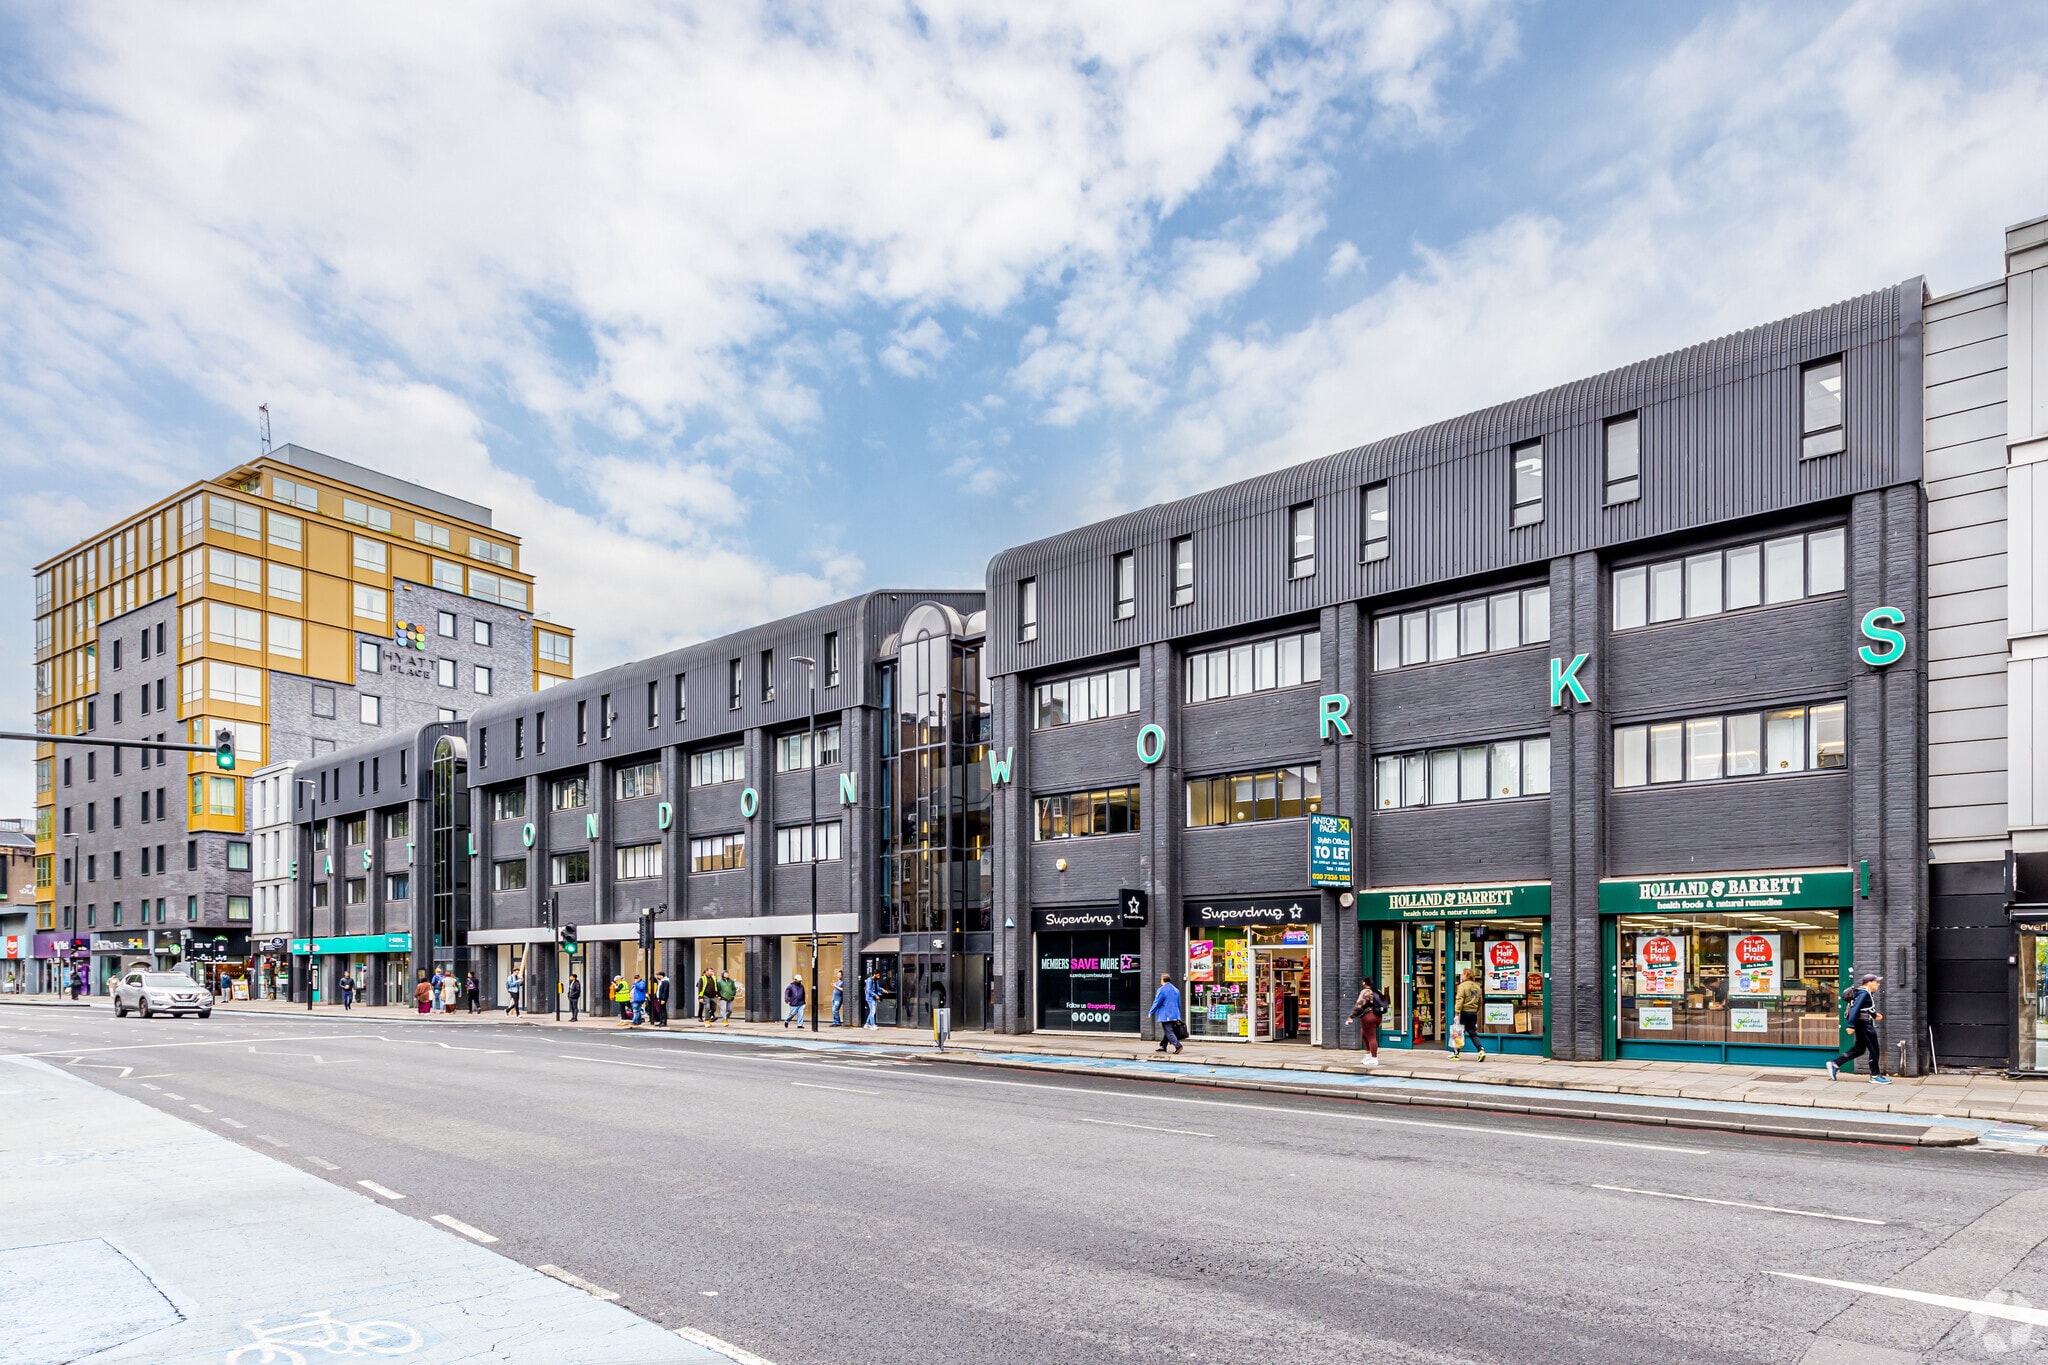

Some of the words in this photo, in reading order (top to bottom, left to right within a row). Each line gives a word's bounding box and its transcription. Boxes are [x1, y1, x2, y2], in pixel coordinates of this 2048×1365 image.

[383, 650, 437, 670] HYATT
[390, 664, 430, 679] PLACE
[289, 841, 415, 880] EAST
[467, 771, 858, 857] LONDON
[987, 606, 1908, 786] WORKS
[1312, 816, 1338, 826] ANTON
[1320, 824, 1338, 834] PAGE
[1314, 845, 1331, 859] TO
[1332, 846, 1350, 860] LET
[1639, 880, 1709, 900] HOLLAND
[1710, 880, 1725, 897] &
[1727, 877, 1803, 895] BARRETT
[1388, 893, 1443, 910] HOLLAND
[1444, 892, 1456, 907] &
[1457, 890, 1514, 906] BARRETT
[1657, 900, 1680, 910] health
[1682, 900, 1704, 909] foods
[1716, 898, 1744, 908] natural
[1745, 897, 1783, 907] remedies
[1201, 906, 1285, 921] Superdrug
[1422, 909, 1439, 917] foods
[1447, 908, 1468, 916] natural
[1469, 907, 1497, 915] remedies
[1045, 913, 1114, 927] Superdrug
[1496, 948, 1513, 957] Half
[1650, 945, 1670, 953] Half
[1743, 944, 1765, 953] Half
[1496, 956, 1514, 964] Price
[1650, 953, 1671, 962] Price
[1743, 953, 1766, 961] Price
[1041, 958, 1070, 970] MEMBERS
[1070, 957, 1099, 970] SAVE
[1100, 957, 1119, 970] MORE
[1087, 1002, 1116, 1011] @superdrug
